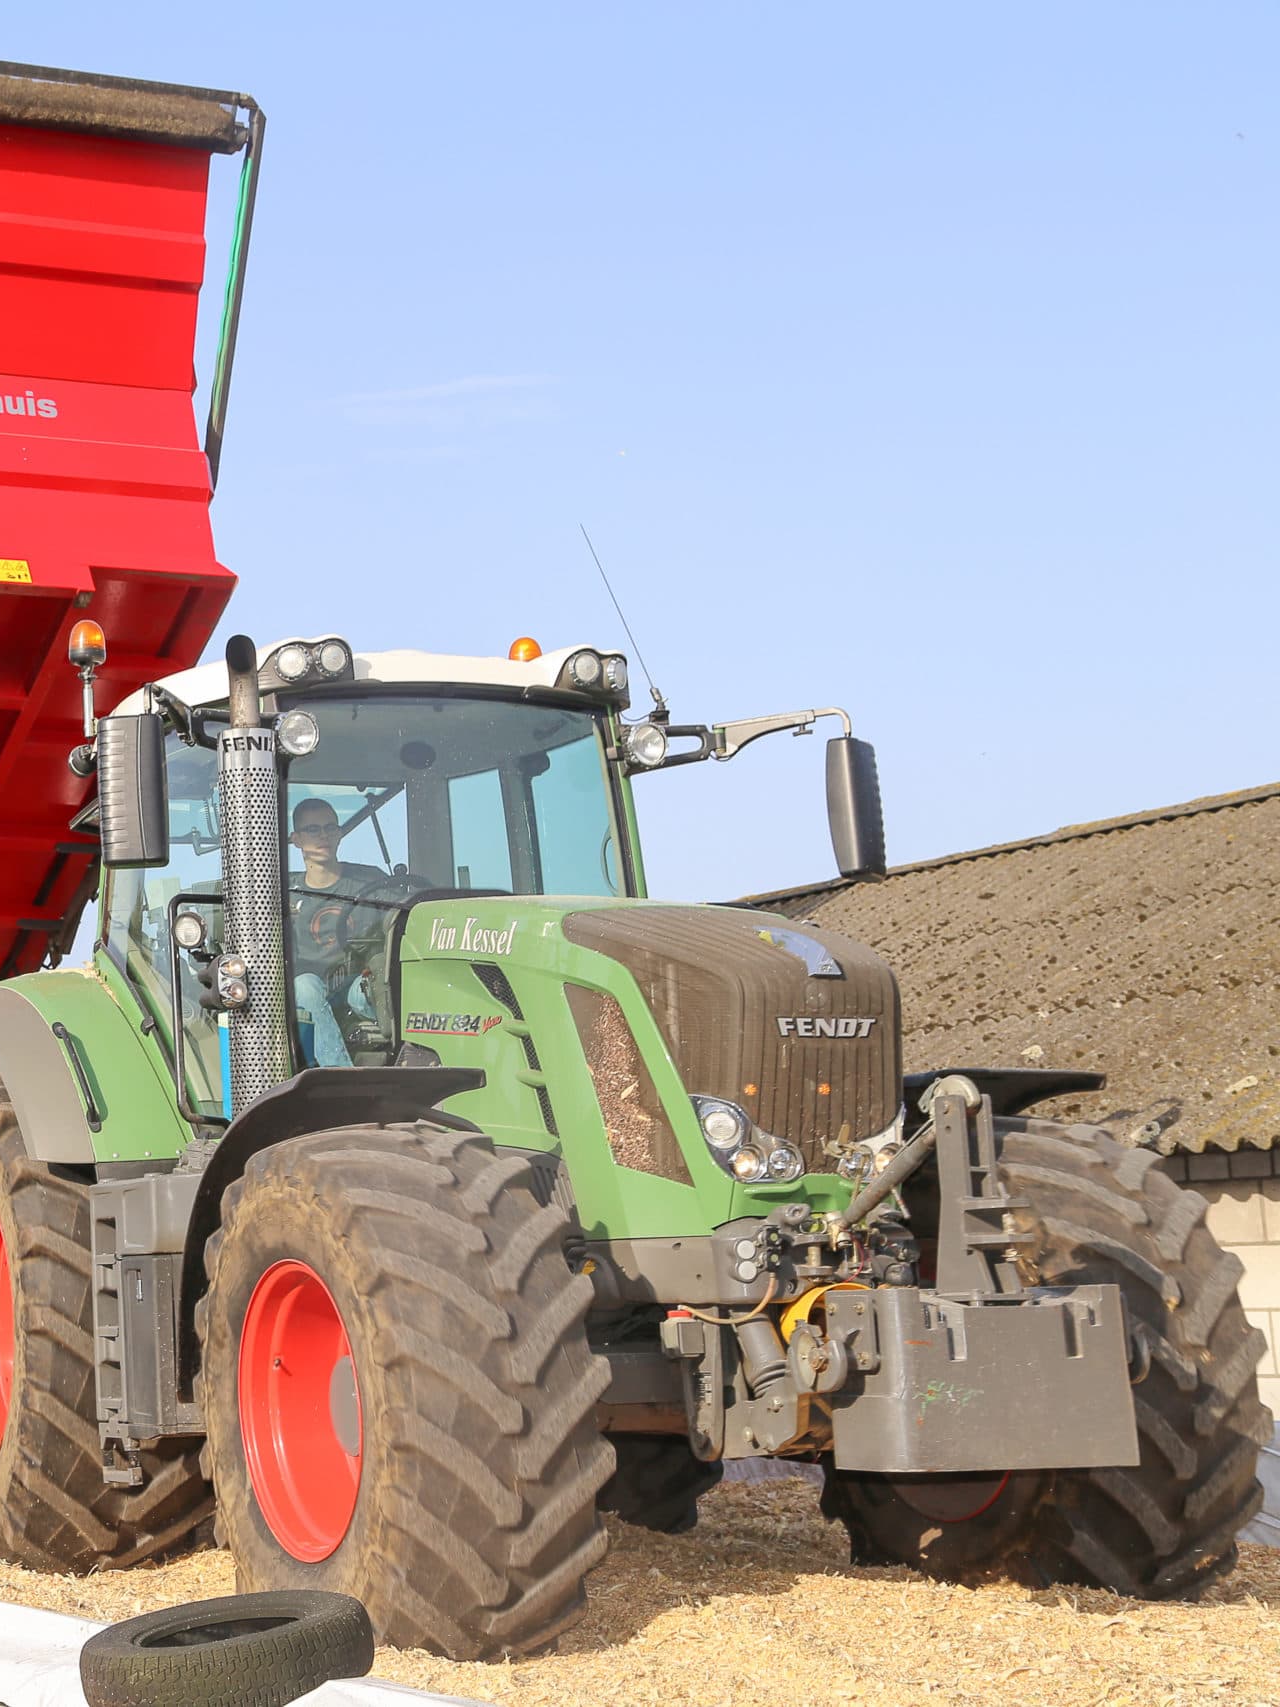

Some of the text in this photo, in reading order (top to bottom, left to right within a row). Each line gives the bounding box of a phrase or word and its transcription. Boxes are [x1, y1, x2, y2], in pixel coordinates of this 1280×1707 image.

[429, 917, 518, 955] Van Kessel
[406, 1012, 452, 1031] FENDT
[776, 1016, 876, 1039] FENDT
